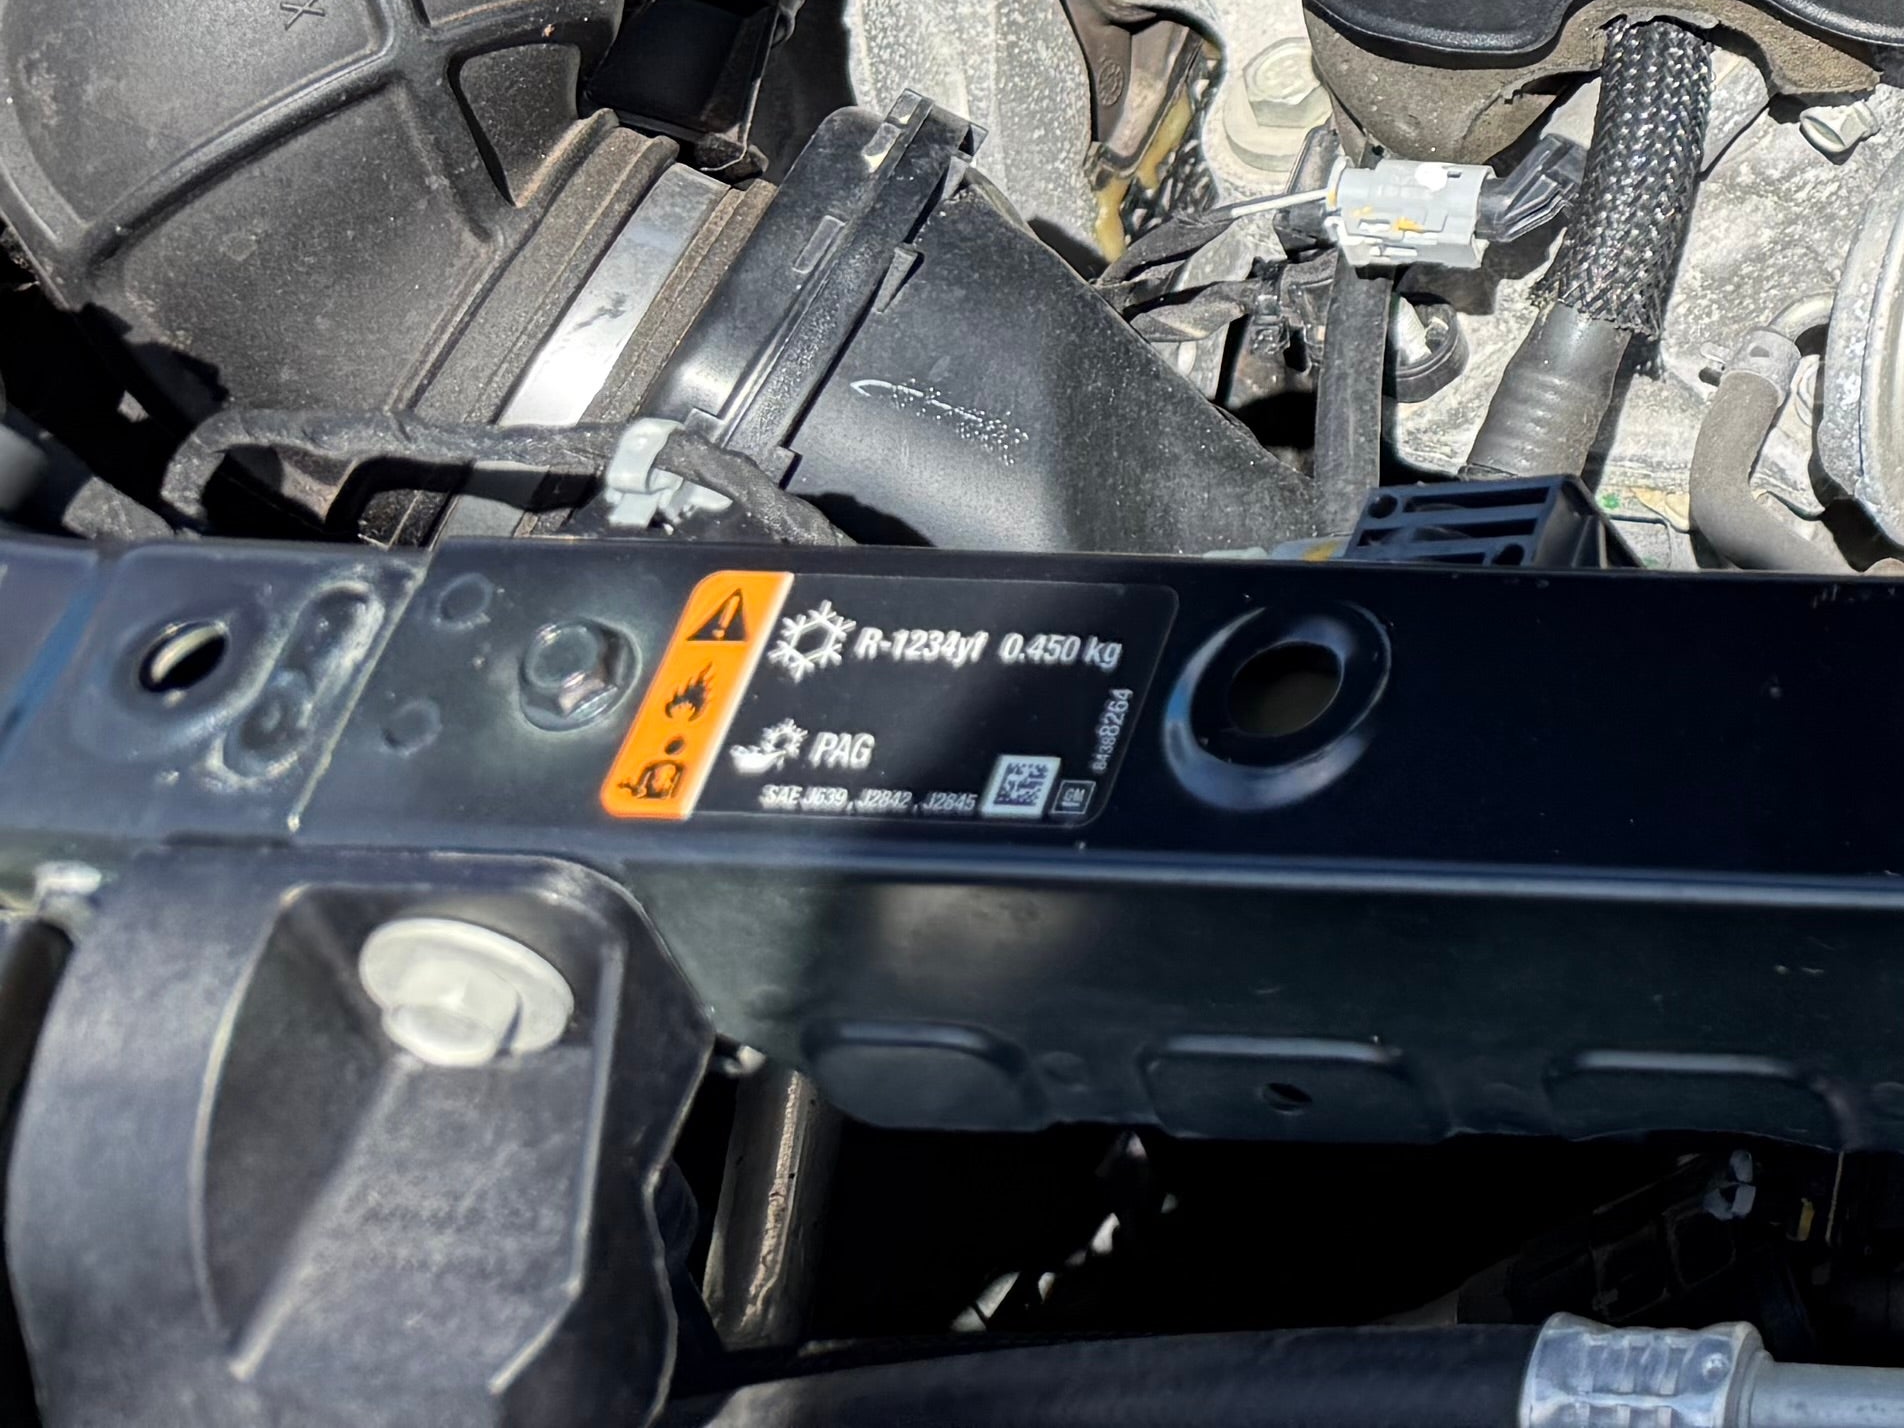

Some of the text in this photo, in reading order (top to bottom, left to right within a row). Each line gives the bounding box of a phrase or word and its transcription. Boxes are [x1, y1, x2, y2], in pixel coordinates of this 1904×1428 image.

[853, 627, 1124, 672] R-1234yf 0.450 kg
[1091, 687, 1135, 774] 84388264
[809, 732, 877, 769] PAG
[758, 784, 801, 809] SAE
[922, 789, 978, 814] J2845
[1060, 787, 1087, 811] GM
